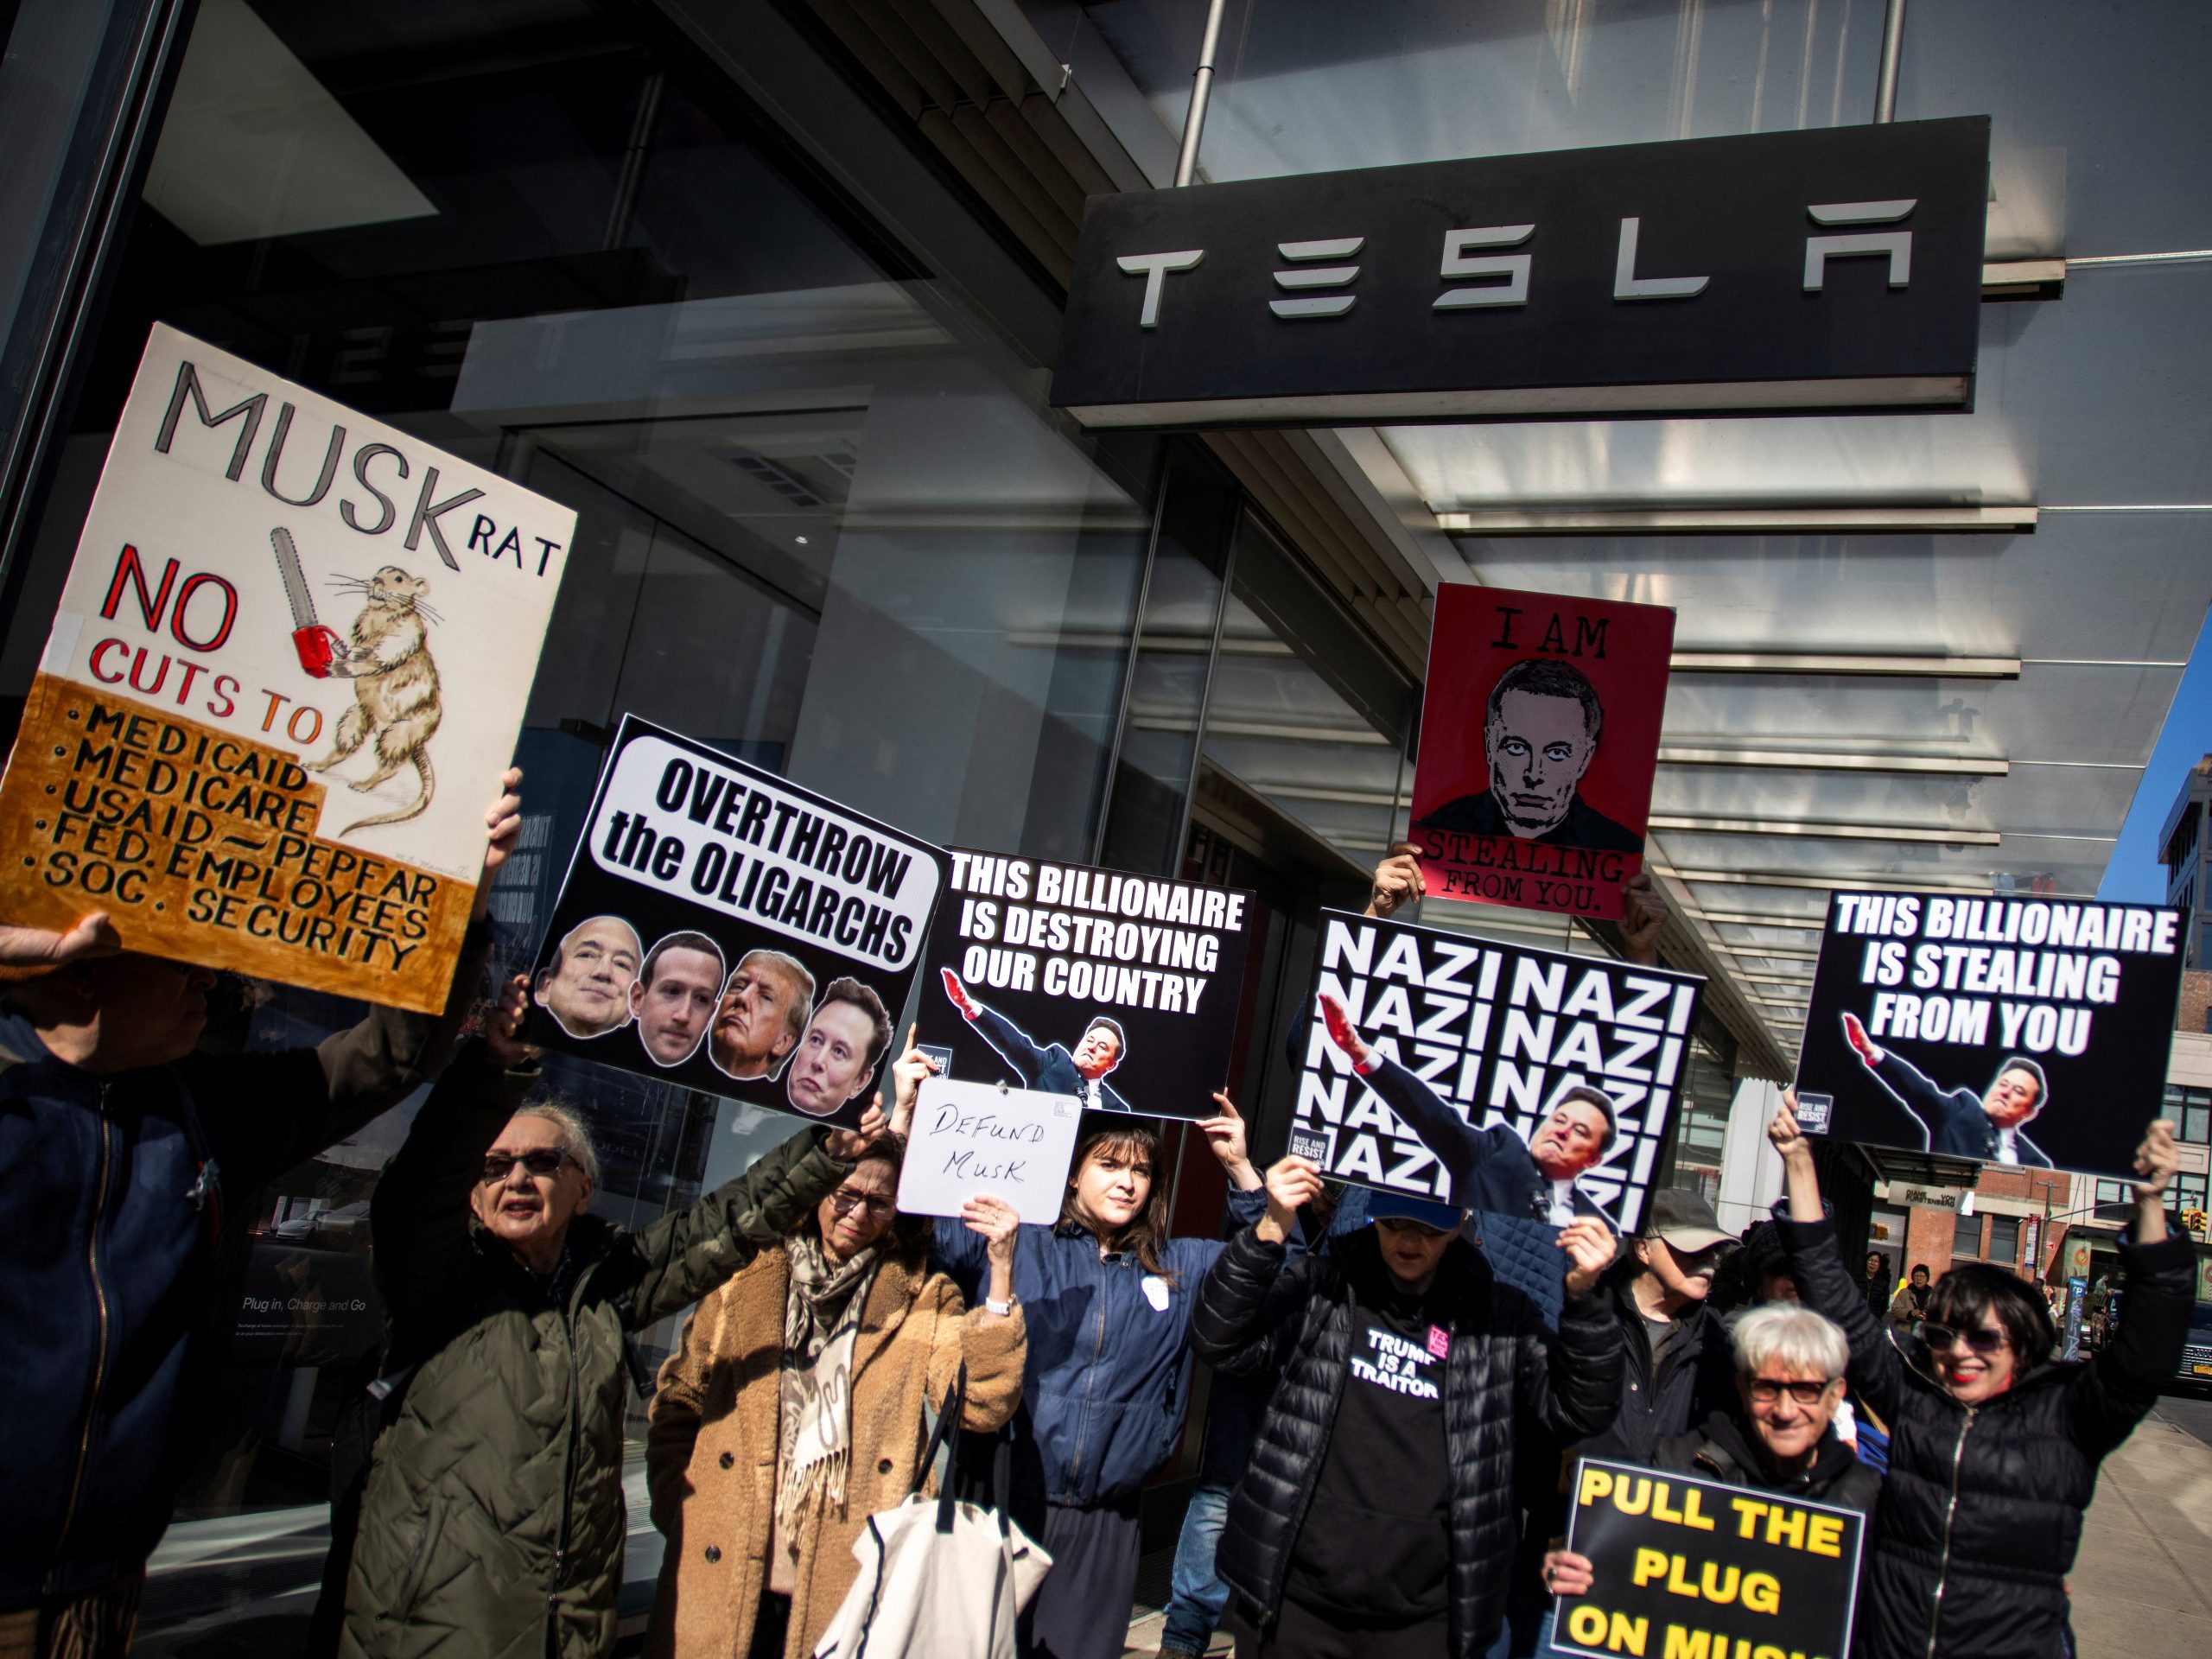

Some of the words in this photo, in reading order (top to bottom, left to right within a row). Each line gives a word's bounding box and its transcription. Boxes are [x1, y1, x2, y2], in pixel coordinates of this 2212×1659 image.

[1116, 198, 1918, 328] TESLA
[99, 543, 238, 652] NO
[1491, 607, 1523, 650] I
[1535, 613, 1611, 659] AM
[90, 638, 240, 717] CUTS
[261, 688, 323, 745] TO
[86, 702, 308, 791] MEDICAID
[73, 739, 316, 836] MEDICARE
[63, 779, 213, 844] USAID
[273, 836, 437, 909] PEPFAR
[656, 758, 912, 900] OVERTHROW
[1423, 831, 1624, 884] STEALING
[52, 815, 156, 868] FED.
[173, 847, 429, 941] EMPLOYEES
[602, 810, 685, 882] the
[690, 842, 913, 965] OLIGARCHS
[950, 851, 1031, 899] THIS
[1036, 865, 1246, 931] BILLIONAIRE
[1442, 869, 1523, 902] FROM
[1535, 880, 1602, 912] YOU.
[188, 891, 418, 973] SECURITY
[959, 899, 998, 941] IS
[1003, 905, 1221, 972] DESTROYING
[1836, 895, 1920, 937] THIS
[1925, 899, 2179, 954] BILLIONAIRE
[962, 945, 1037, 992] OUR
[1043, 957, 1207, 1015] COUNTRY
[1322, 919, 1503, 1001] NAZI
[1510, 957, 1695, 1036] NAZI
[1861, 942, 1907, 985] IS
[1912, 945, 2121, 1003] STEALING
[1314, 971, 1492, 1052] NAZI
[1500, 1008, 1683, 1086] NAZI
[1870, 991, 1992, 1046] FROM
[1999, 1002, 2093, 1056] YOU
[929, 1103, 1045, 1143] DEFUND
[1294, 1135, 1310, 1147] RISE
[1311, 1140, 1326, 1150] AND
[1296, 1071, 1470, 1143] NA
[1292, 1143, 1325, 1160] RESIST
[242, 1297, 269, 1313] Plug
[287, 1298, 327, 1313] Charge
[328, 1300, 348, 1311] and
[351, 1300, 366, 1311] Go
[1351, 1357, 1439, 1400] TRAITOR
[1378, 1352, 1400, 1374] IS
[1401, 1361, 1416, 1378] A
[1579, 1468, 1715, 1531] PULL
[1732, 1497, 1844, 1558] THE
[1632, 1548, 1781, 1616] PLUG
[1569, 1605, 1649, 1657] ON
[1663, 1624, 1832, 1659] MU
